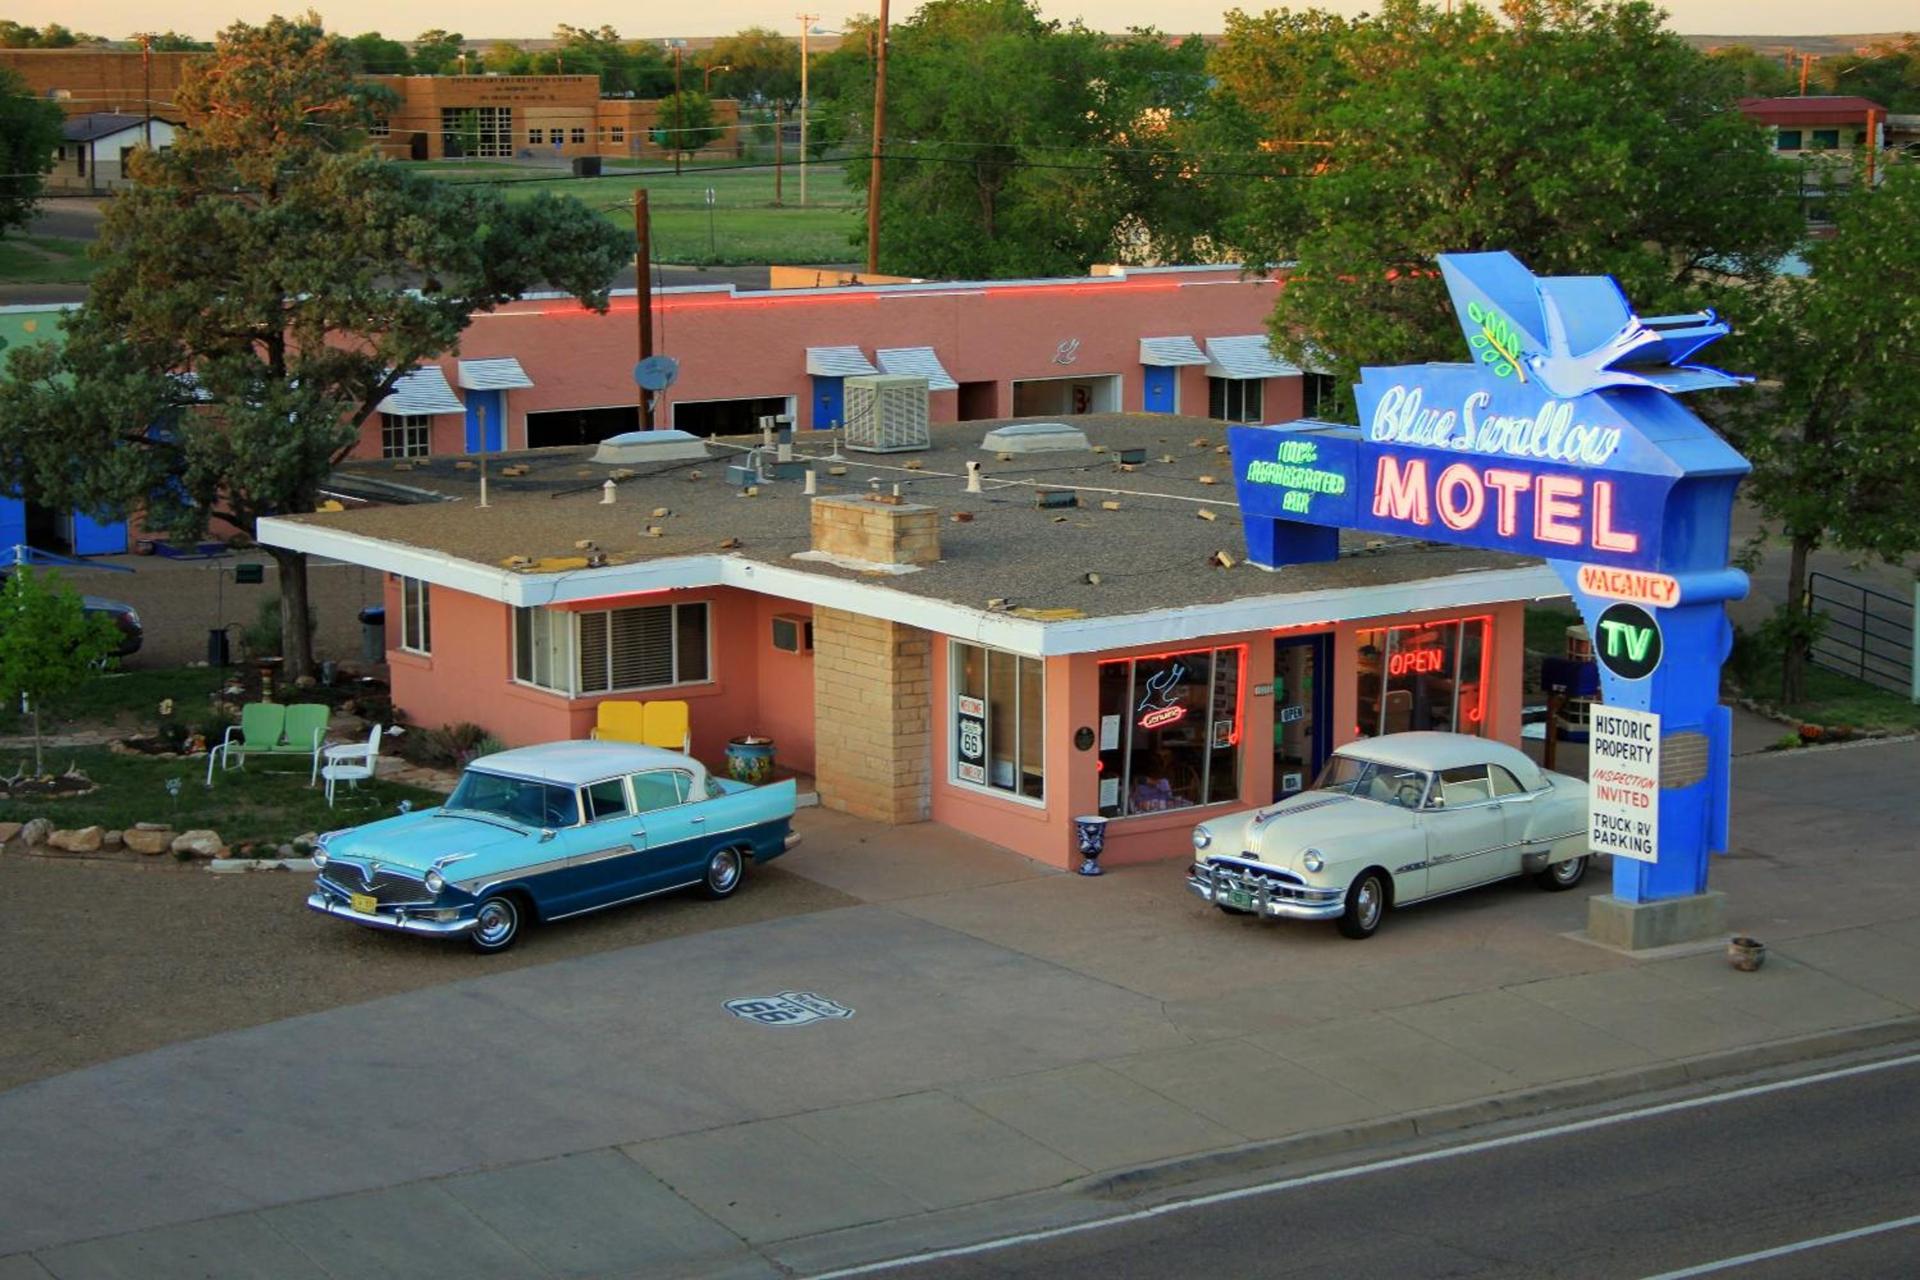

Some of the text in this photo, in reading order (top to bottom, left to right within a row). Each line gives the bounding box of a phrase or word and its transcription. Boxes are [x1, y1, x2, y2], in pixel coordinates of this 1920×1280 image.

[1371, 385, 1622, 465] Blue Swallow
[1278, 440, 1318, 463] 100%
[1372, 456, 1639, 553] MOTEL
[1583, 567, 1676, 602] VACANCY
[1599, 619, 1654, 663] TV
[1390, 649, 1442, 675] OPEN
[1595, 714, 1653, 742] HISTORIC
[964, 733, 978, 753] 66
[1595, 737, 1653, 764] PROPERTY
[1592, 769, 1656, 790] INSPECTION
[1596, 784, 1650, 809] INVITED
[1593, 812, 1652, 837] TRUCK RV
[1593, 828, 1653, 855] PARKING
